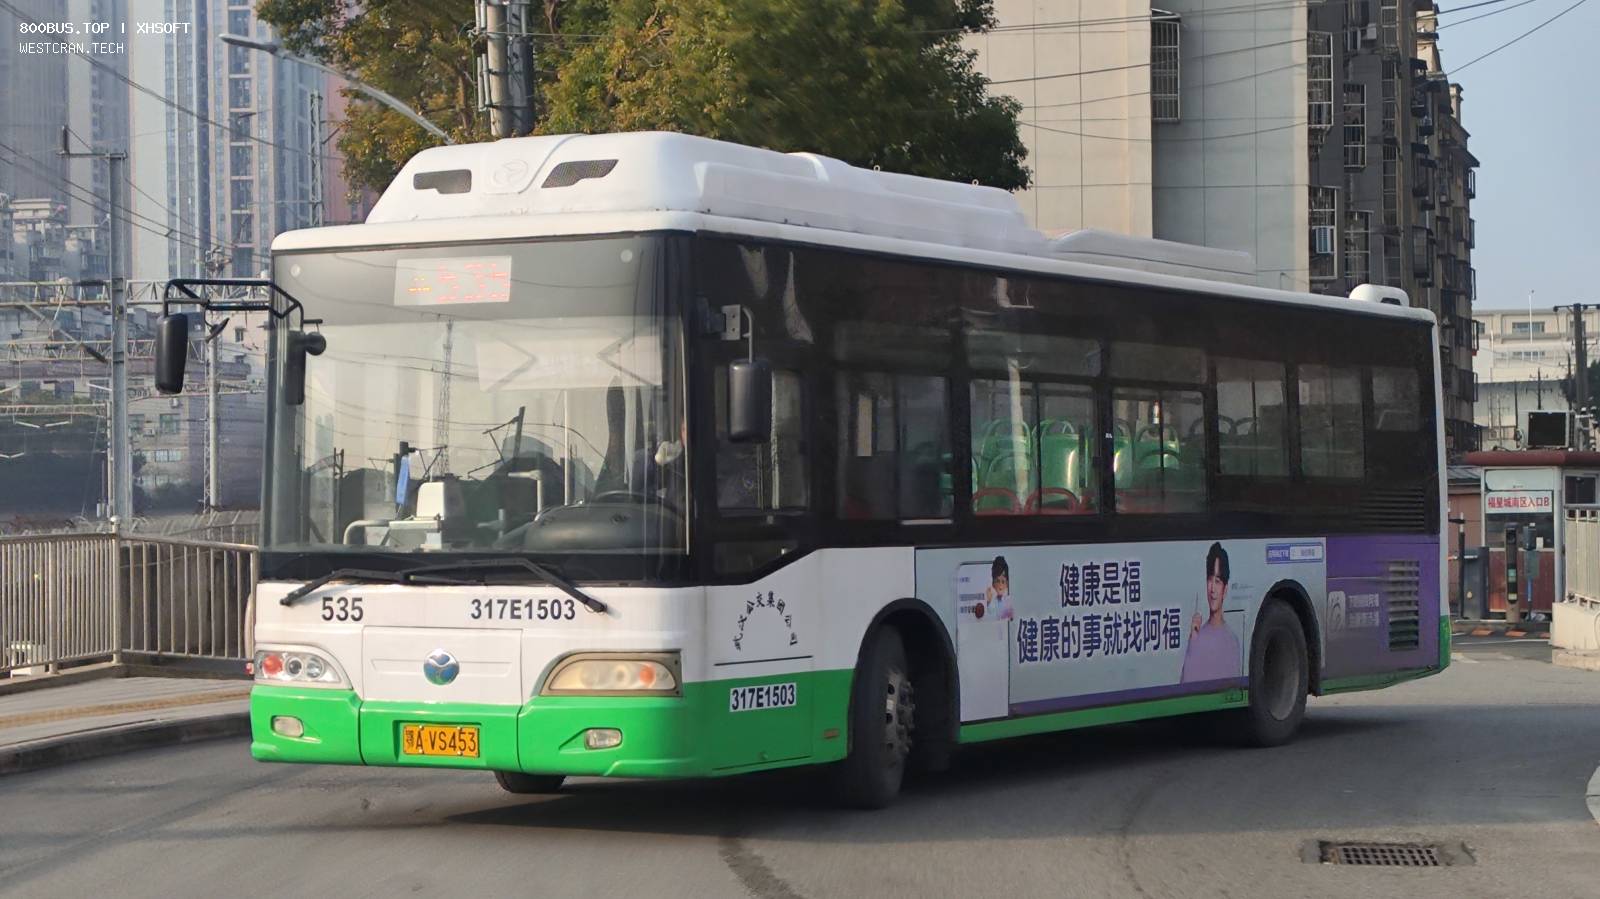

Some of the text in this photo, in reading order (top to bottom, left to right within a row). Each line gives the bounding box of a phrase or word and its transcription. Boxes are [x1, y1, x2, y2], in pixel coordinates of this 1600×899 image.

[1059, 560, 1141, 608] 健康是福
[321, 597, 364, 621] 535
[471, 599, 576, 620] 317E1503
[1017, 608, 1181, 664] 健康的事就找阿福
[731, 684, 795, 710] 317E1503
